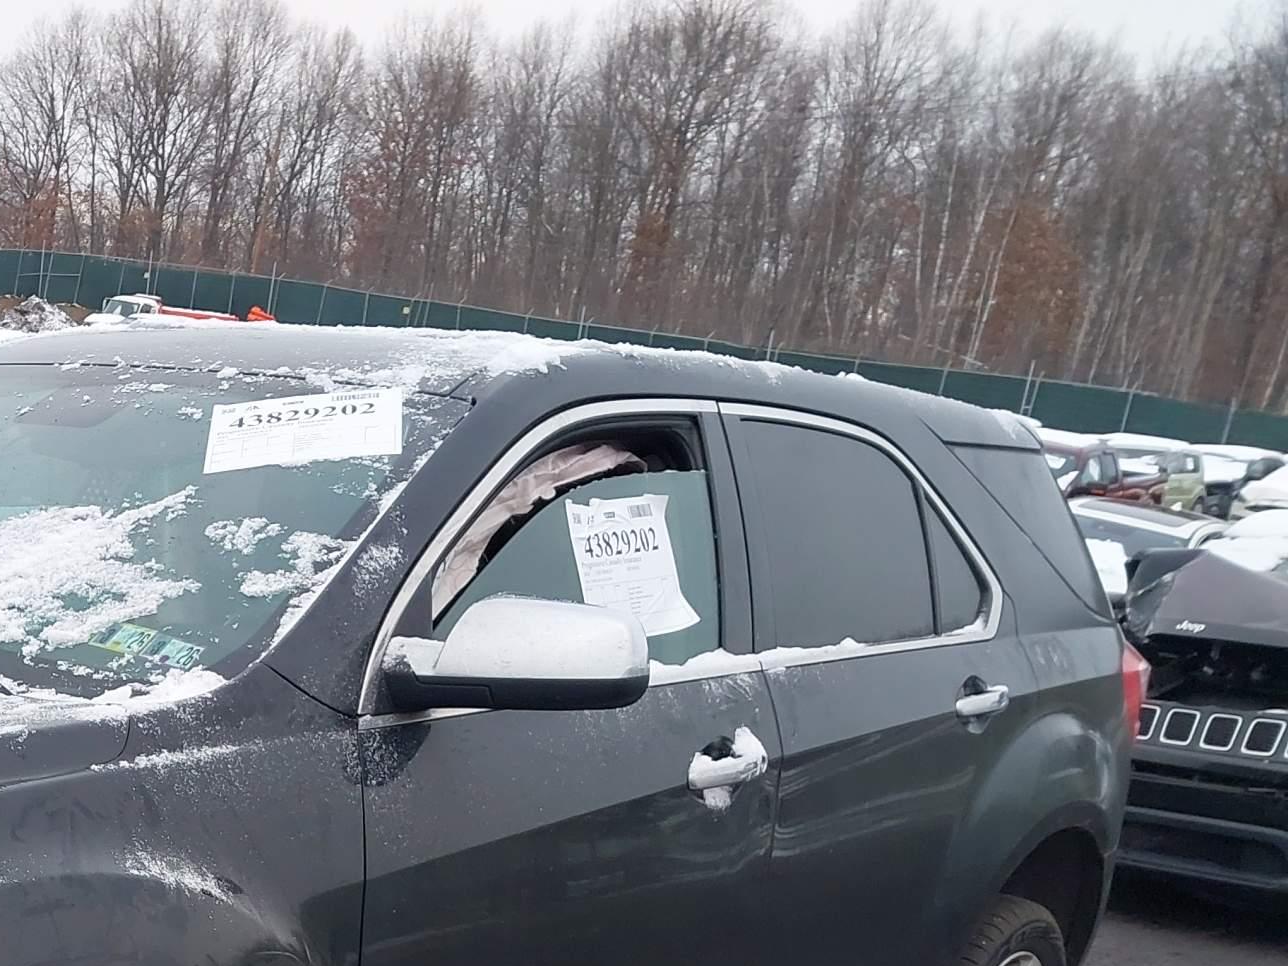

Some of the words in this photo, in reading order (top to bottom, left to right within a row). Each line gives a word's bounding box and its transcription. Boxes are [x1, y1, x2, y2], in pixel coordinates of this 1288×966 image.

[228, 402, 377, 428] 43829202
[584, 527, 659, 558] 43829202
[1175, 620, 1206, 634] Jeep
